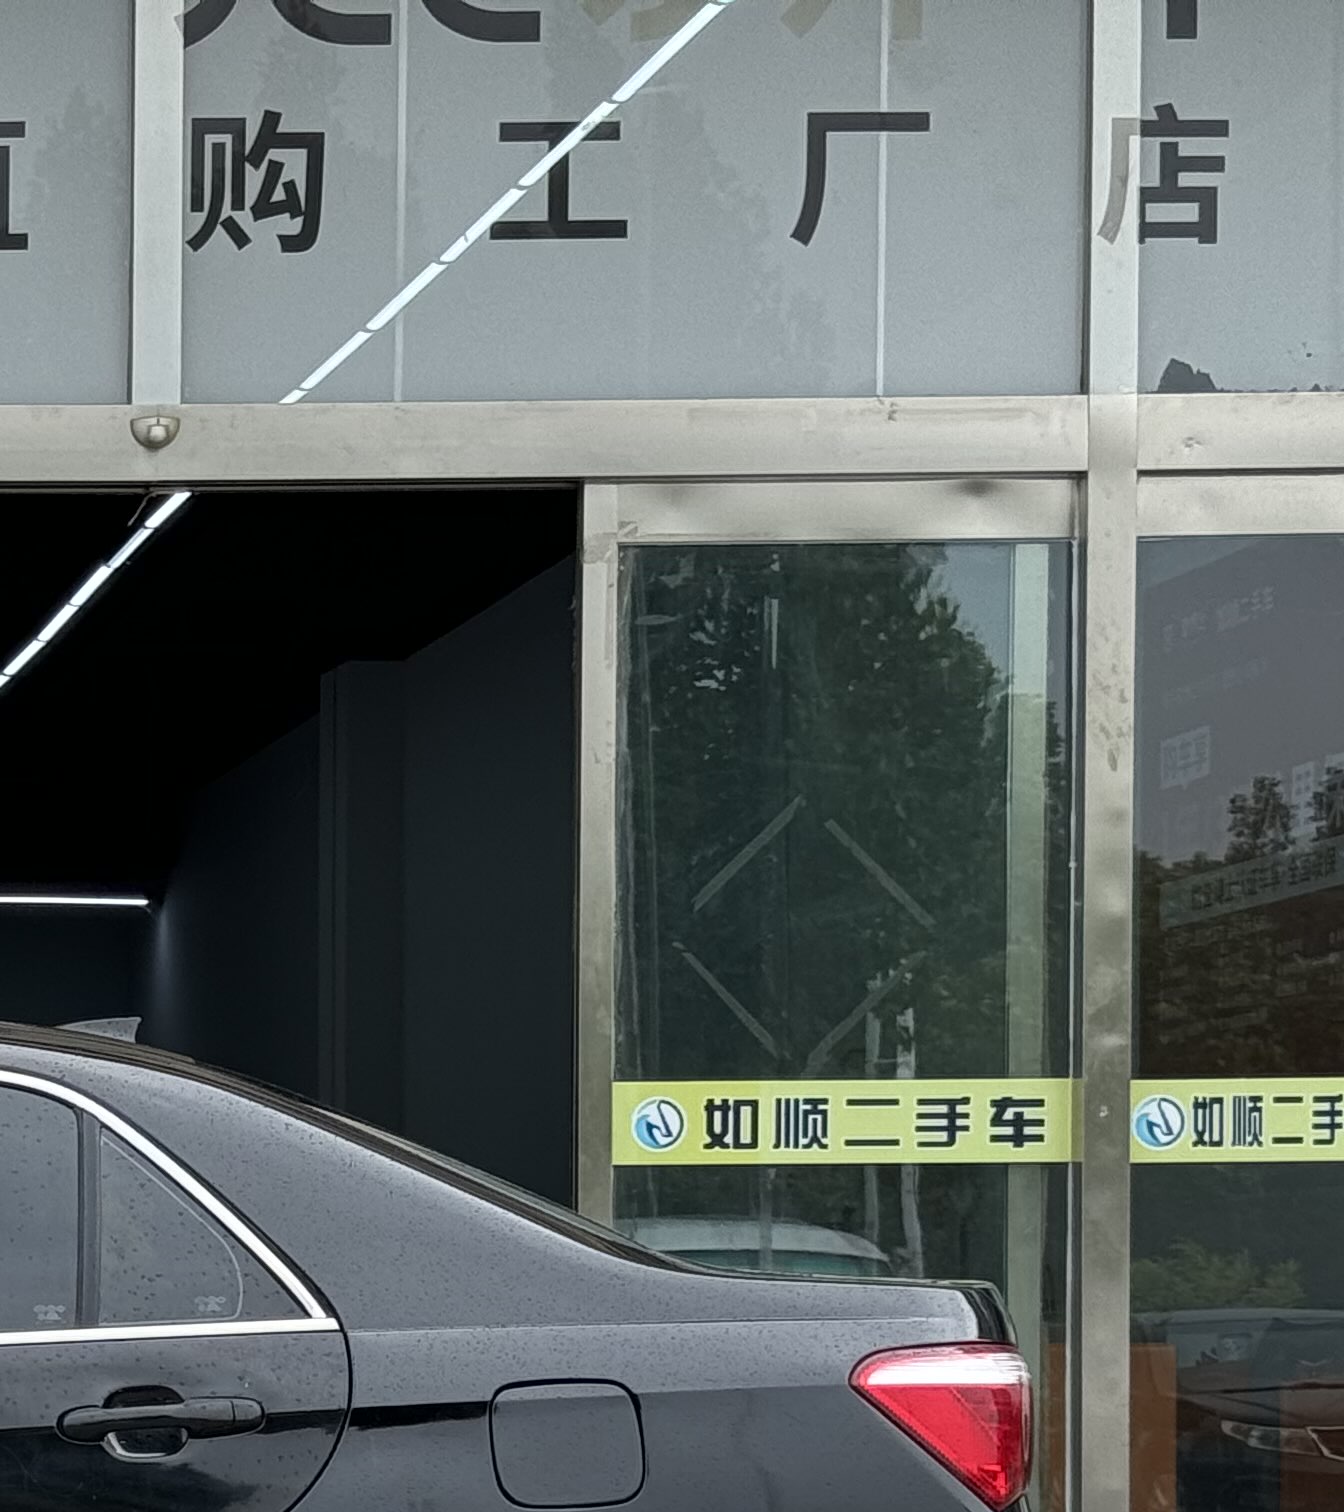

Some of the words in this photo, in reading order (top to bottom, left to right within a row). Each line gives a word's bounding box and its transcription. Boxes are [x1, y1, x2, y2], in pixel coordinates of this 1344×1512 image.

[703, 1096, 1046, 1150] 如顺二手车
[1192, 1094, 1343, 1148] 如顺二手
